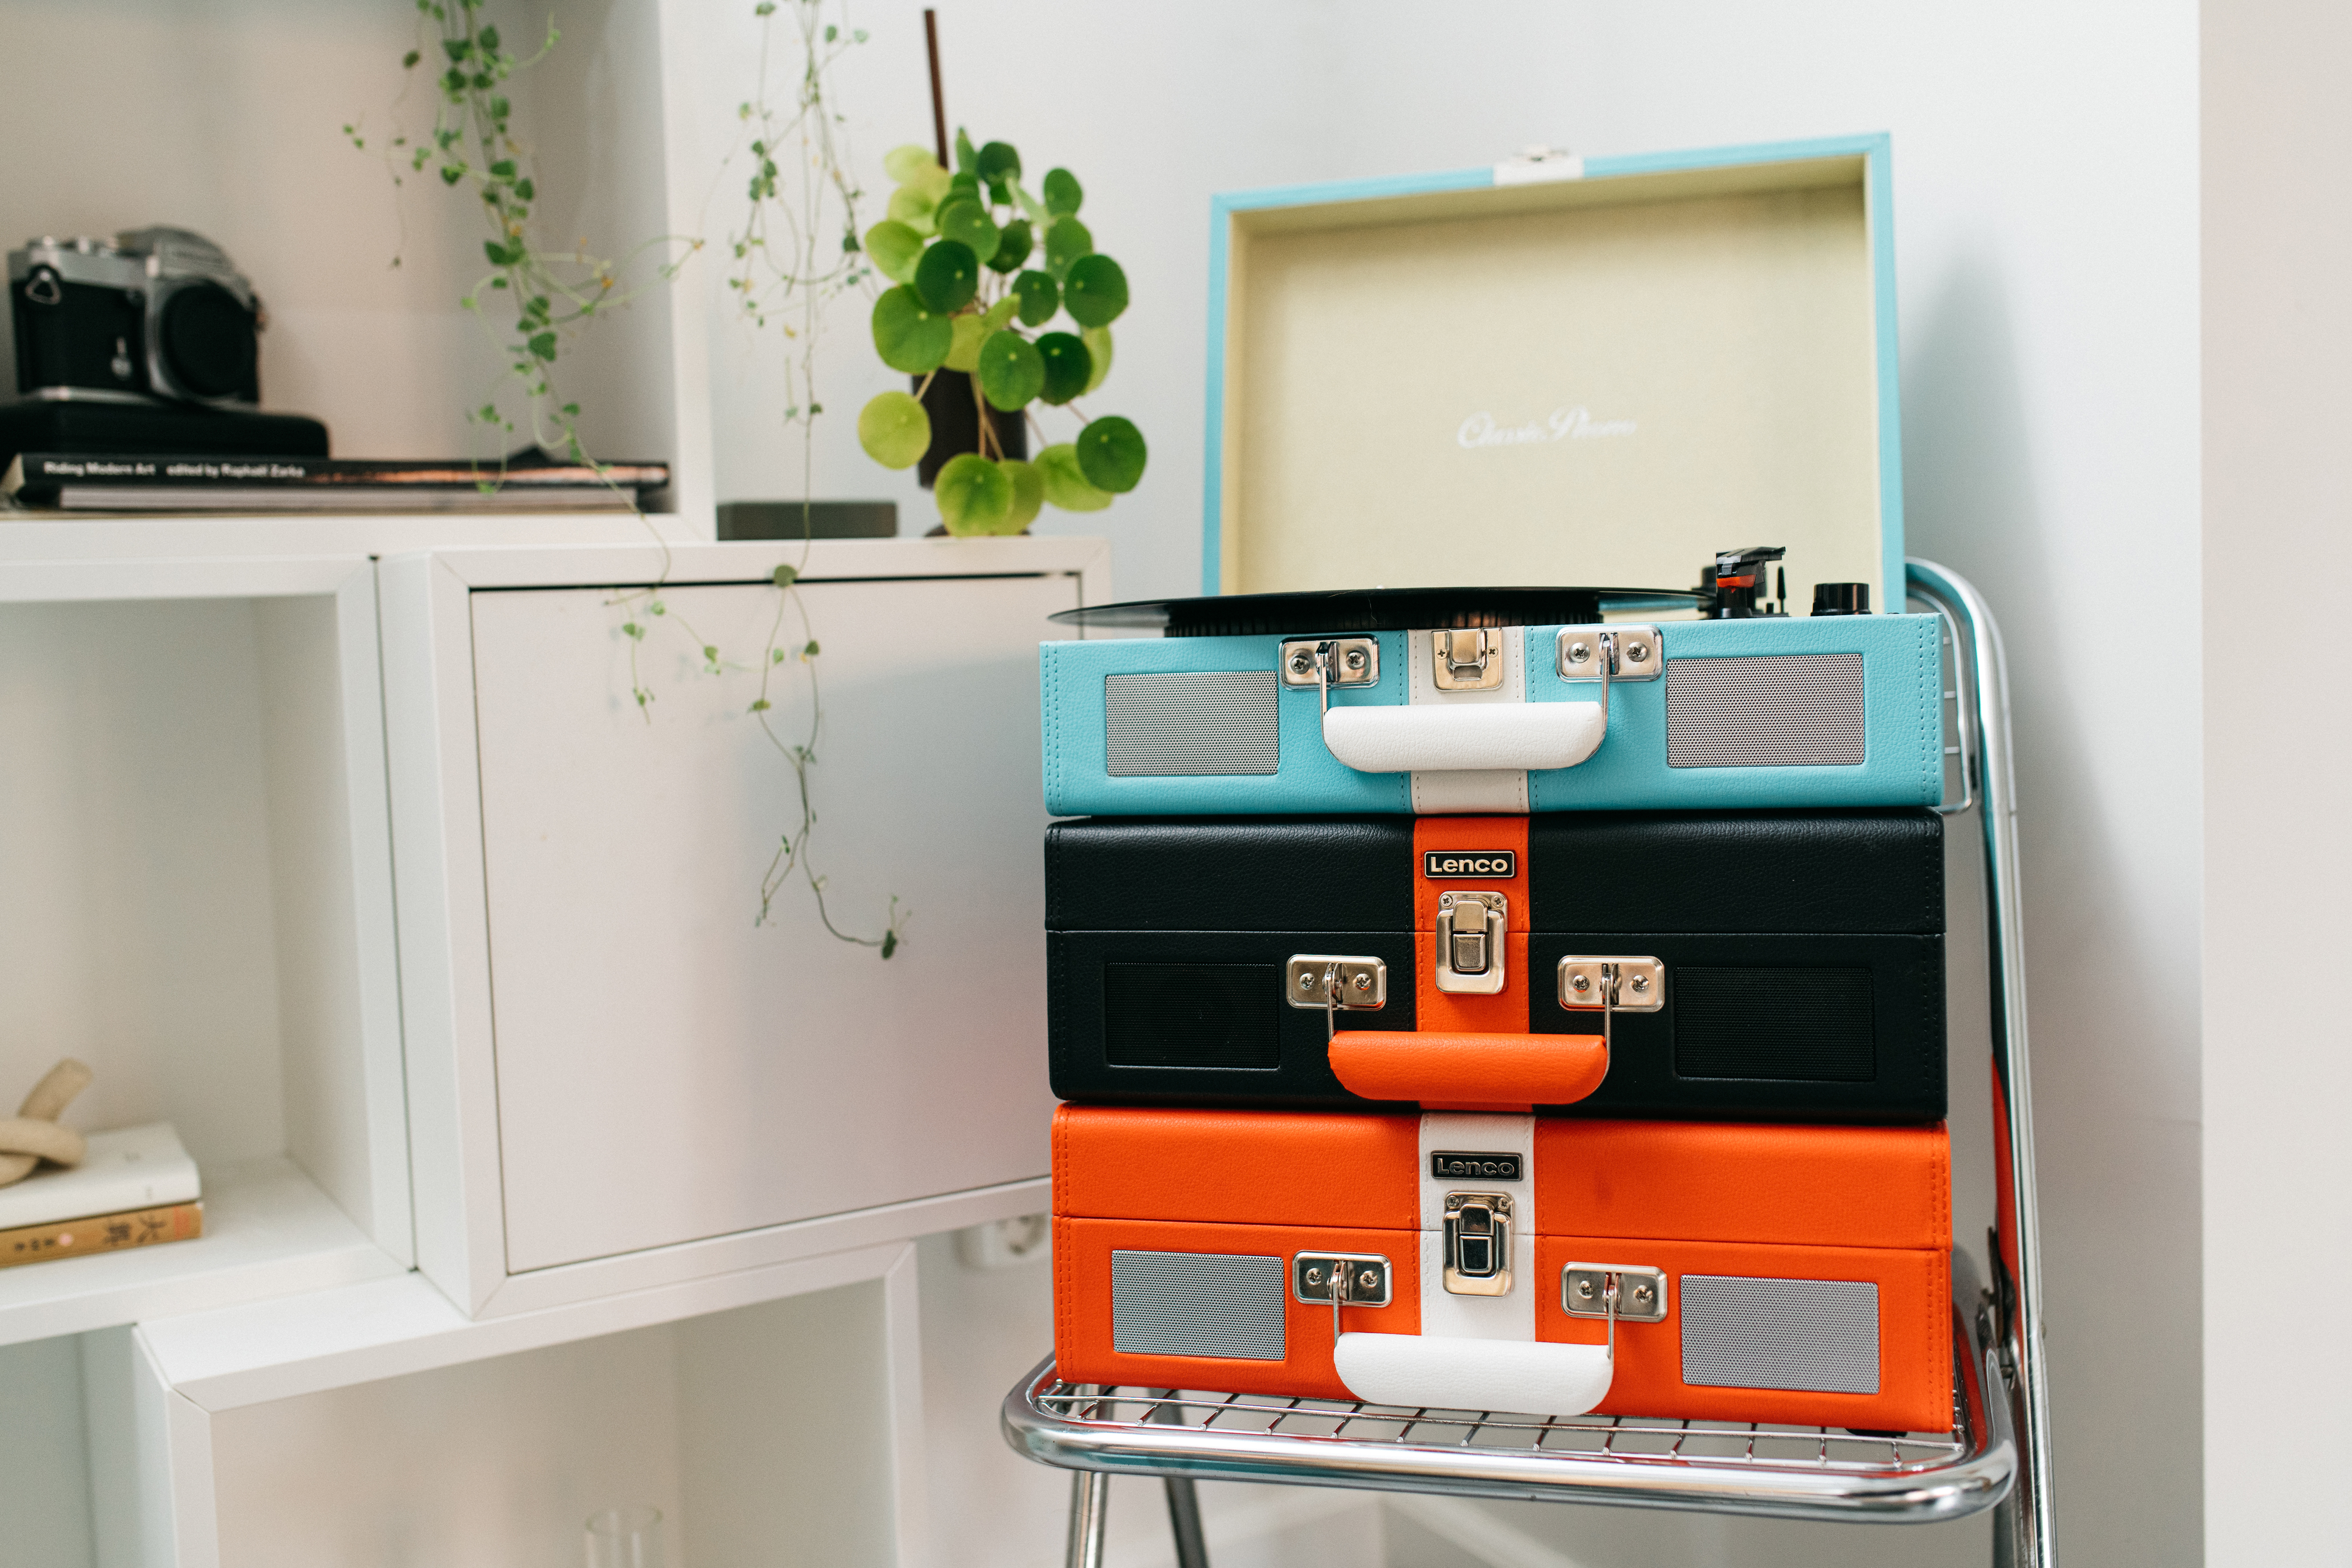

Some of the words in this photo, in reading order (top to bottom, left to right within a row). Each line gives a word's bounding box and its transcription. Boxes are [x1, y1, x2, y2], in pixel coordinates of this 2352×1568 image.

[86, 462, 133, 475] Modern
[136, 462, 156, 476] Art
[166, 463, 203, 476] edited
[204, 463, 219, 479] by
[1431, 856, 1508, 873] Lenco
[1437, 1158, 1515, 1176] Lenco
